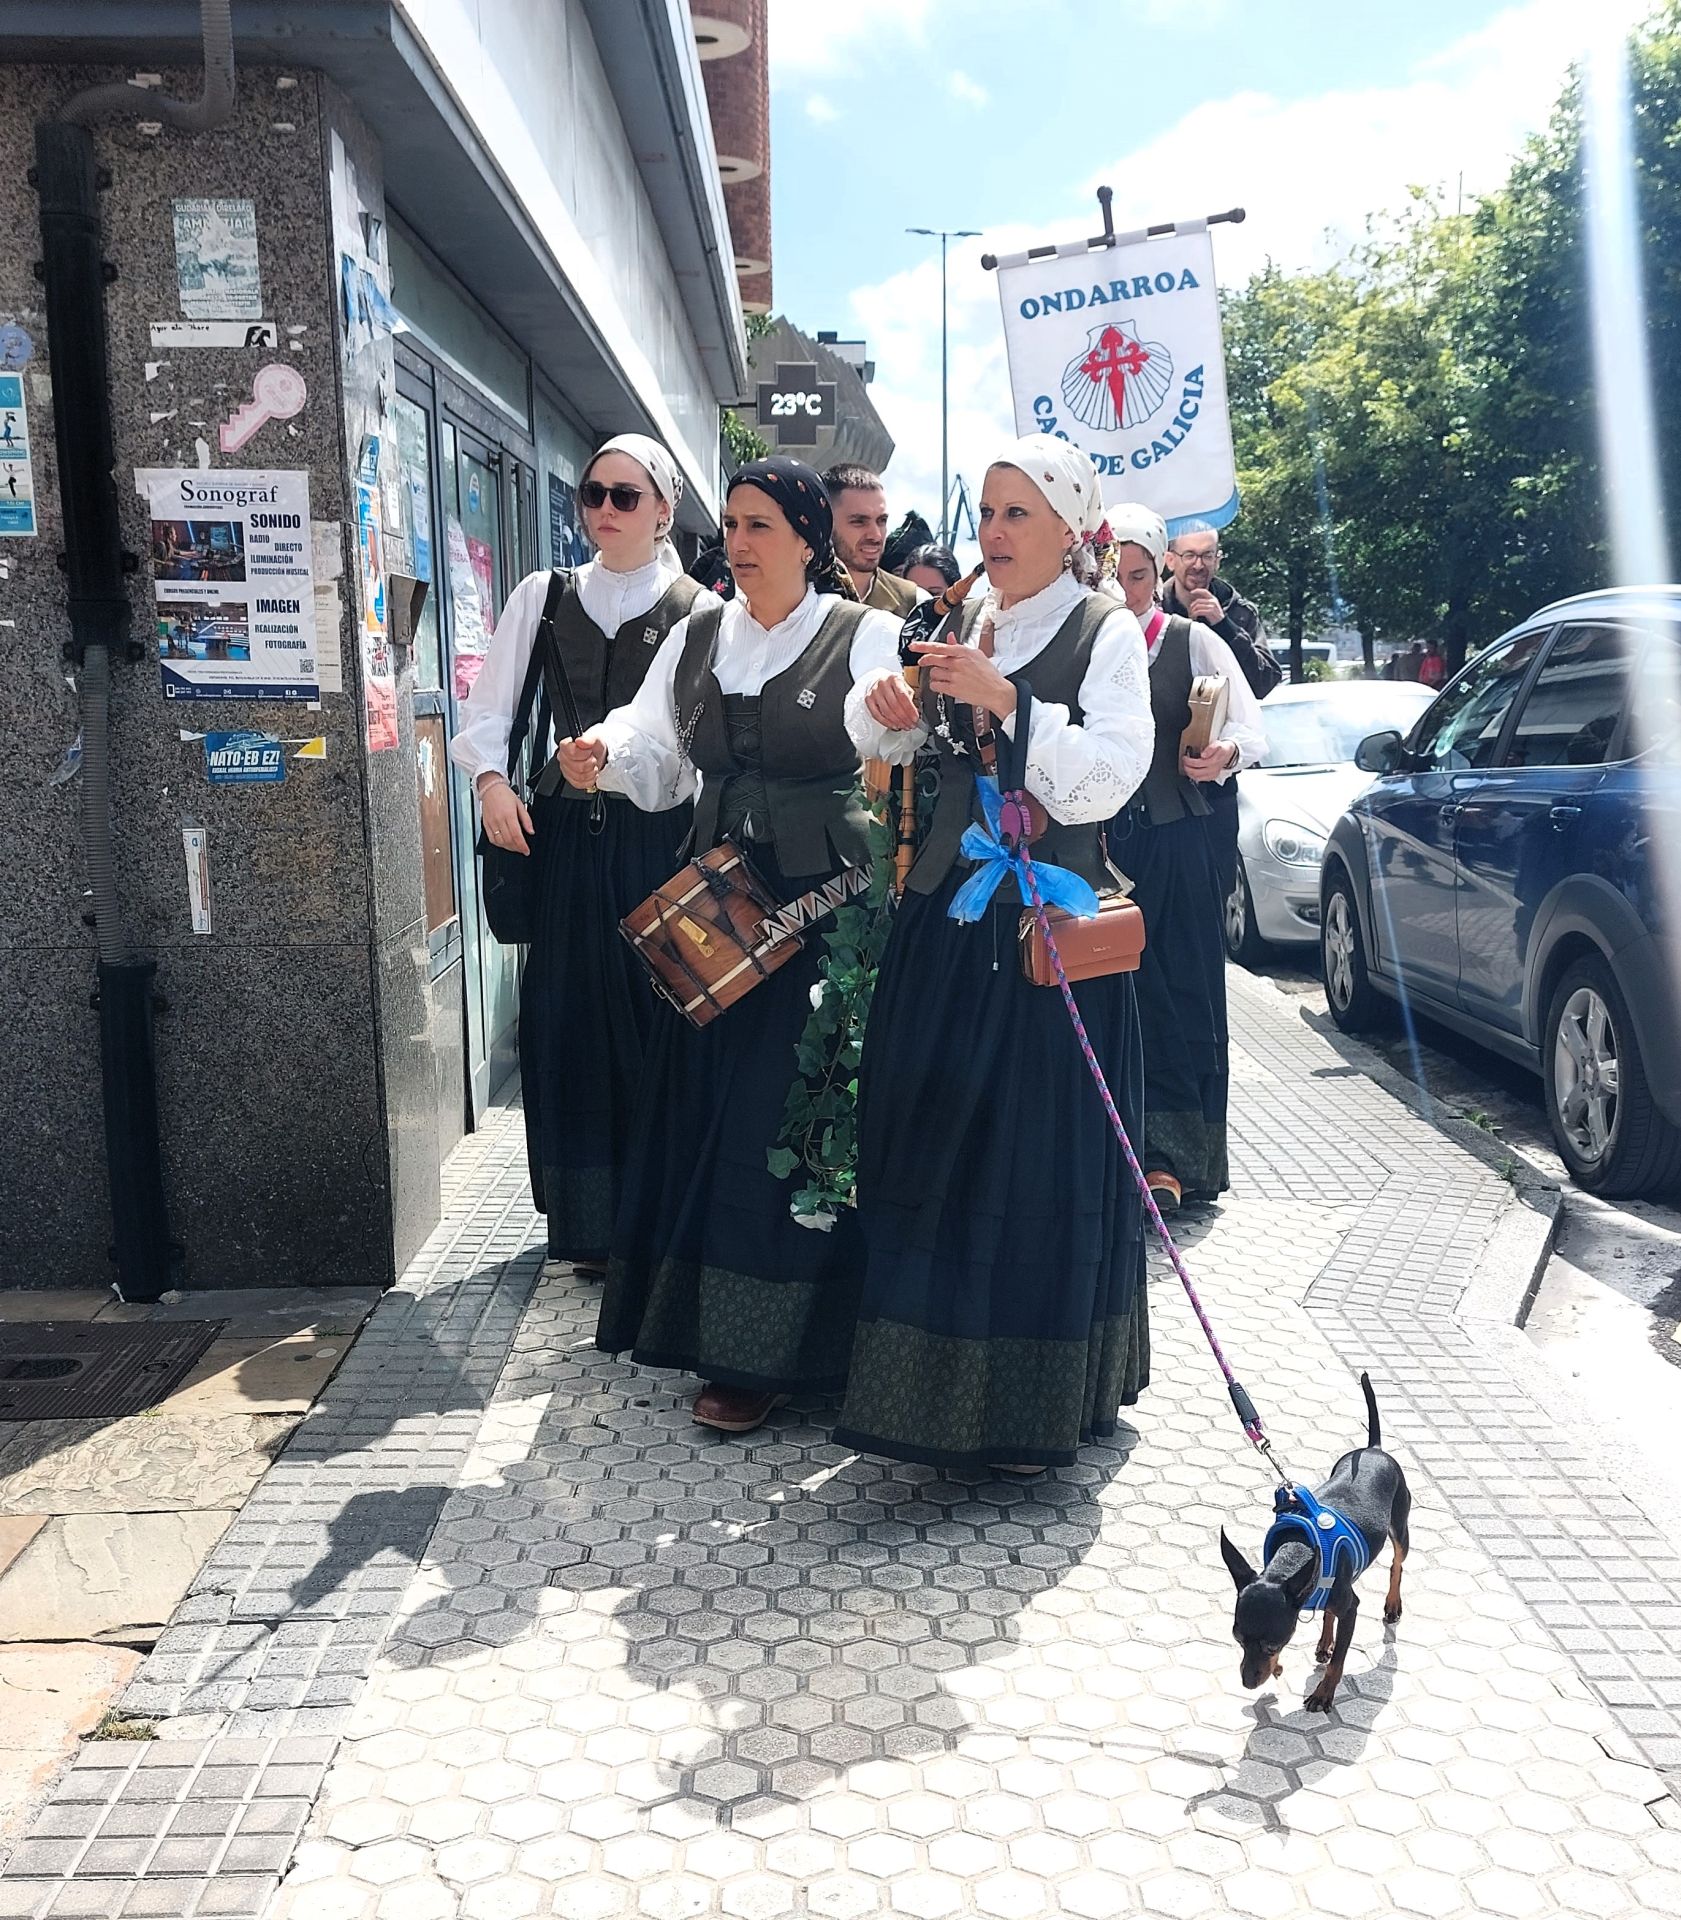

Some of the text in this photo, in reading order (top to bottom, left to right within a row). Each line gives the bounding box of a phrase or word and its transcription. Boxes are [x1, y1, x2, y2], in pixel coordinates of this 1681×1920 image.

[1020, 268, 1200, 320] ONDARROA
[1090, 452, 1125, 476] DE
[1131, 364, 1204, 470] GALICIA
[180, 479, 279, 507] Sonograf
[250, 513, 301, 529] SONIDO
[249, 534, 270, 544] RADIO
[274, 542, 303, 552] DIRECTO
[250, 554, 294, 564] ILUMINACIÓN
[286, 567, 310, 576] MUSICAL
[256, 598, 301, 614] IMAGEN
[254, 623, 299, 634] REALIZACIÓN
[264, 638, 307, 649] FOTOGRAFÍA
[261, 750, 280, 766] EZ!
